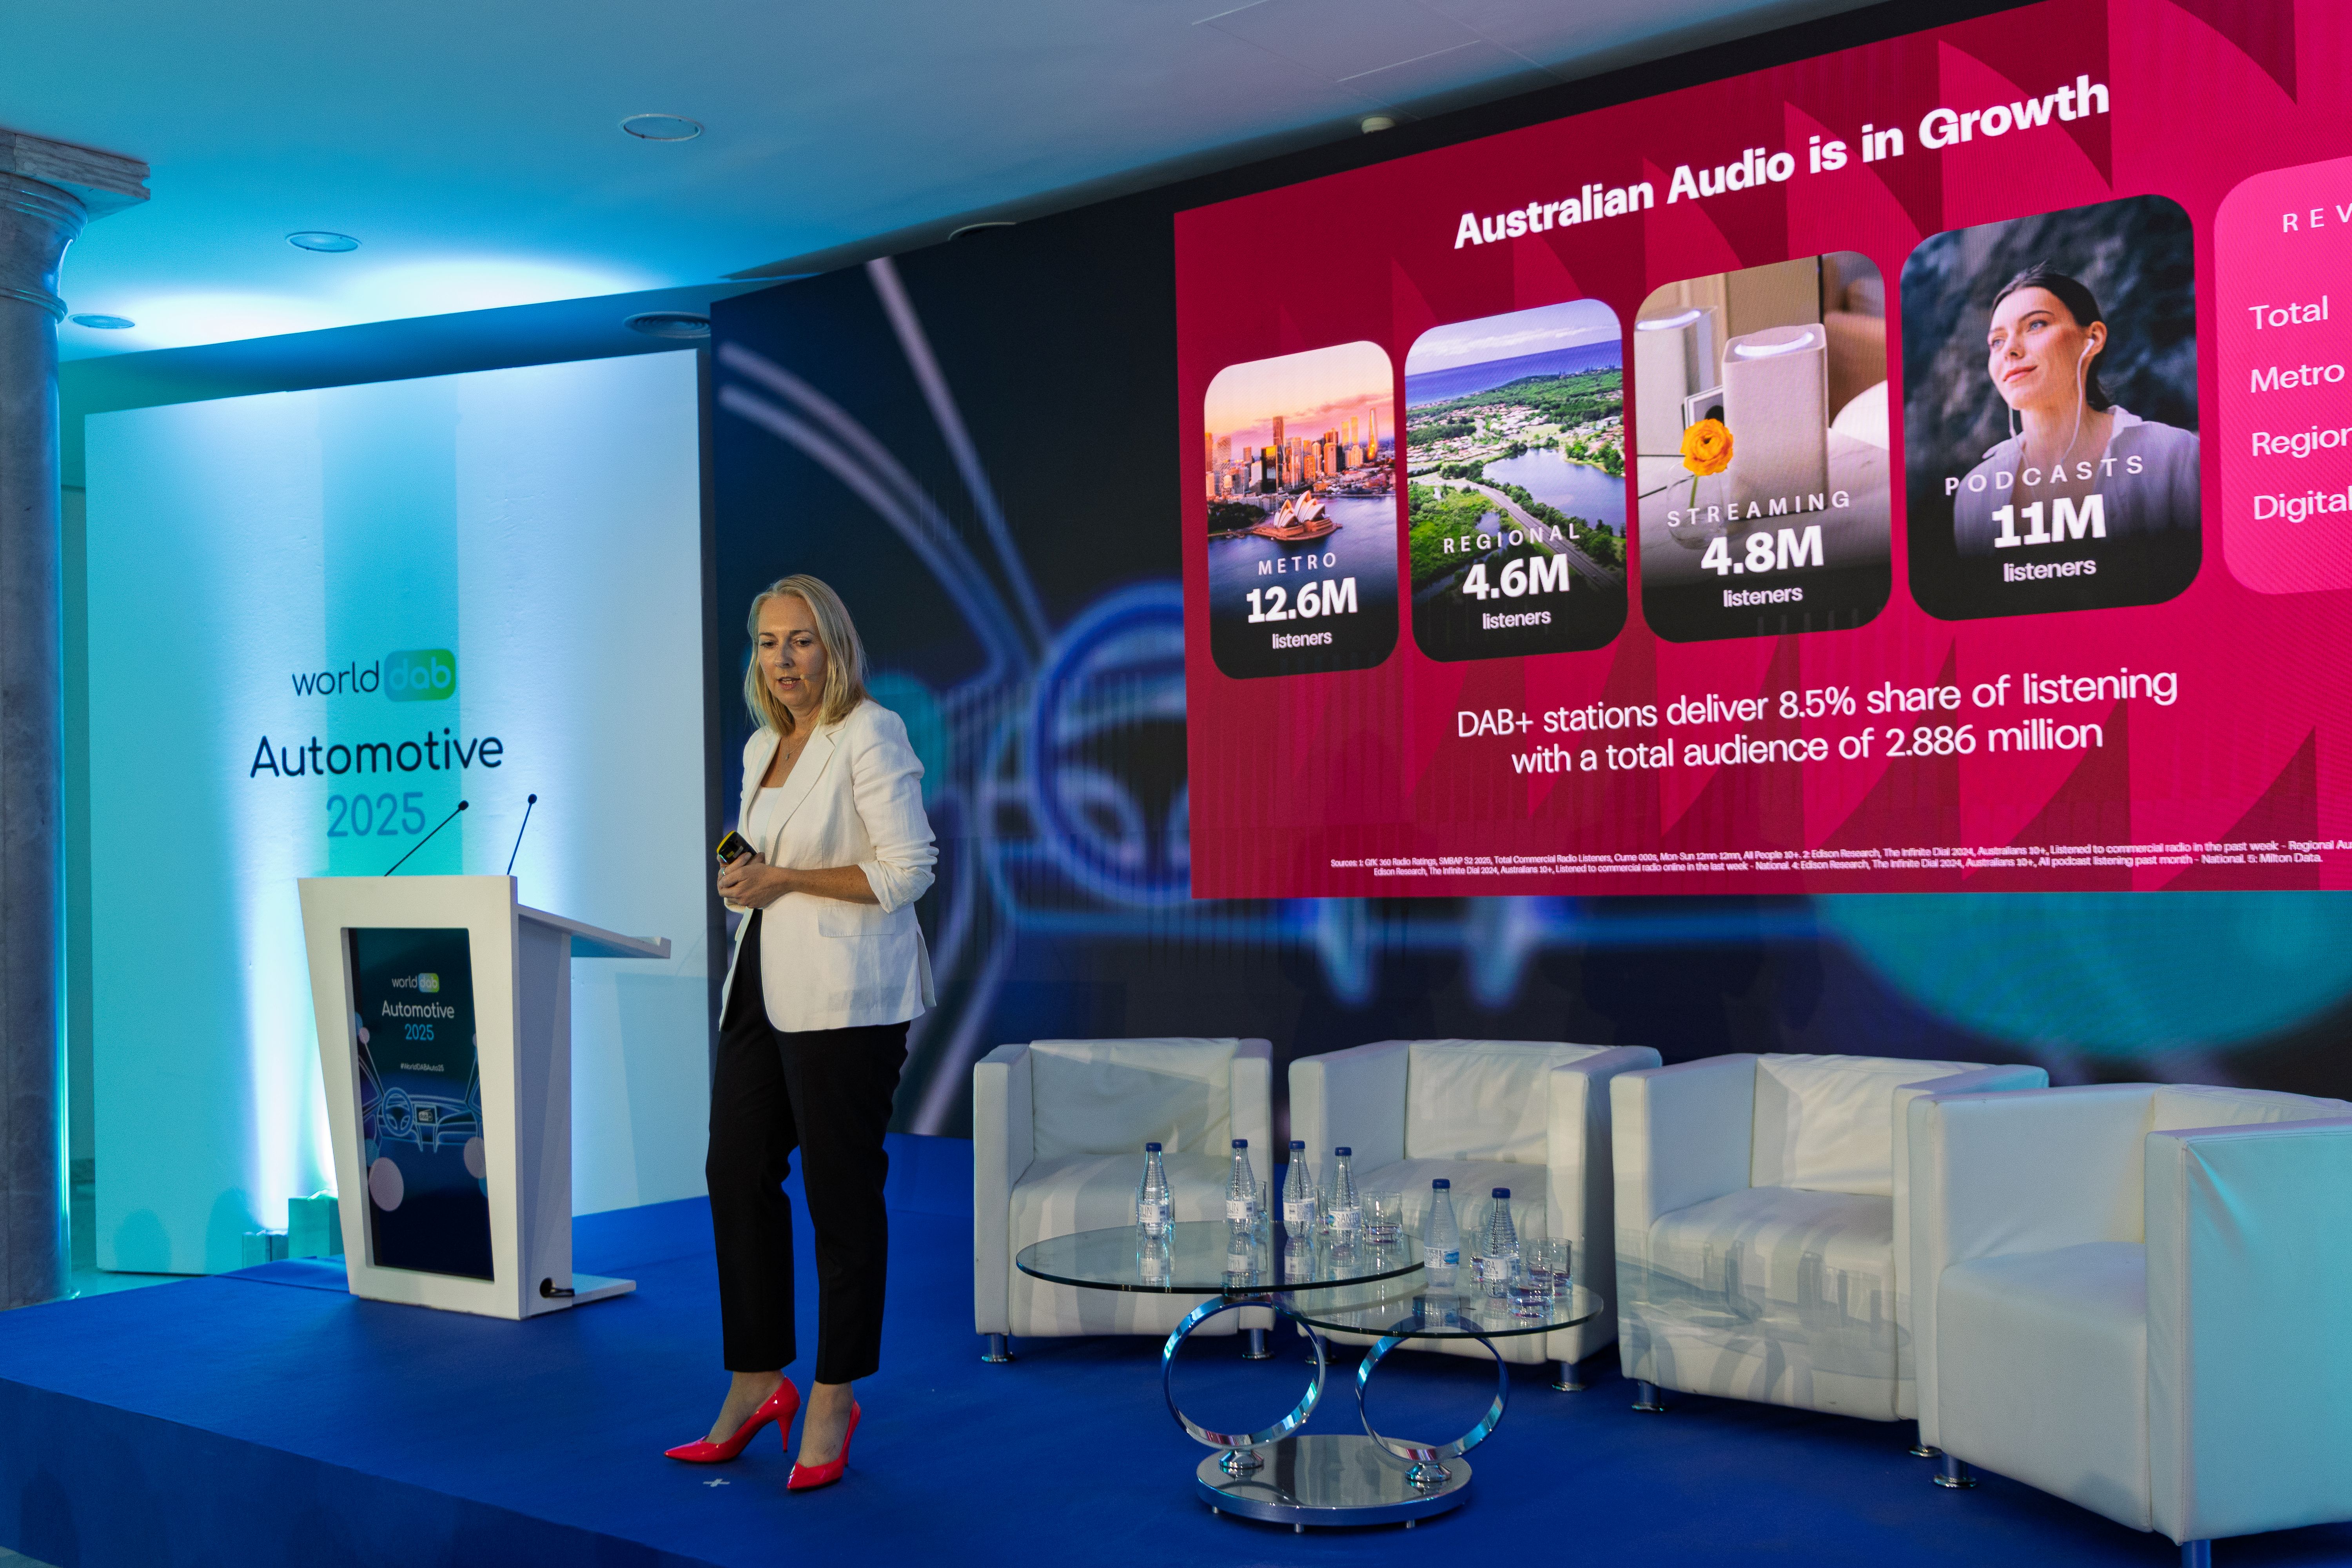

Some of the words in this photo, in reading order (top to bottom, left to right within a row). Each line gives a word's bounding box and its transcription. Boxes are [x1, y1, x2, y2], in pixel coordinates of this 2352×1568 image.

[1454, 182, 1654, 250] Australian
[1666, 147, 1795, 205] Audio
[1809, 135, 1847, 174] is
[1861, 123, 1904, 163] in
[1918, 74, 2109, 149] Growth
[2248, 294, 2328, 330] Total
[2250, 364, 2345, 393] Metro
[1945, 455, 2143, 496] PODCASTS
[1667, 489, 1850, 528] STREAMING
[1992, 494, 2106, 548] 11M
[2253, 485, 2352, 523] Digital
[1443, 523, 1580, 554] REGIONAL
[1701, 525, 1824, 575] 4.8M
[1258, 552, 1336, 576] METRO
[1462, 553, 1570, 600] 4.6M
[2003, 559, 2097, 583] listeners
[1246, 577, 1357, 624] 12.6M
[1723, 584, 1803, 608] listeners
[1482, 611, 1552, 630] listeners
[1272, 632, 1333, 650] listeners
[292, 660, 379, 696] world
[389, 656, 452, 691] dab
[1457, 708, 1534, 738] DAB+
[1543, 701, 1658, 733] stations
[1666, 693, 1769, 726] deliver
[1779, 686, 1856, 719] 8.5%
[1866, 681, 1961, 714] share
[1972, 673, 2011, 708] of
[2023, 667, 2178, 706] listening
[250, 728, 503, 778] Automotive
[1511, 743, 1572, 774] with
[1579, 749, 1597, 771] a
[1605, 737, 1674, 770] total
[1683, 733, 1829, 766] audience
[1838, 727, 1875, 760] of
[1885, 724, 1976, 757] 2.886
[1988, 717, 2103, 752] million
[327, 791, 425, 837] 2025
[1331, 859, 1357, 867] Sources:
[1392, 857, 1411, 866] Radio
[1412, 857, 1438, 867] Ratings,
[1494, 856, 1512, 864] Total
[1513, 855, 1556, 864] Commercial
[1557, 854, 1578, 863] Radio
[1578, 854, 1613, 864] Listeners,
[1614, 853, 1637, 862] Cume
[1743, 851, 1754, 860] All
[1755, 851, 1783, 861] People
[1811, 849, 1840, 858] Edison
[1840, 848, 1882, 859] Research,
[1883, 848, 1900, 857] The
[1901, 848, 1932, 857] Infinite
[1932, 847, 1950, 857] Dial
[1977, 846, 2027, 856] Australians
[2050, 844, 2091, 855] Listened
[2092, 844, 2105, 854] to
[2105, 843, 2164, 853] commercial
[2165, 842, 2192, 852] radio
[2192, 842, 2203, 852] in
[2204, 841, 2222, 852] the
[2223, 842, 2247, 854] past
[2249, 840, 2279, 851] week
[2288, 840, 2334, 853] Regional
[1374, 867, 1395, 876] Edison
[1396, 867, 1428, 877] Research,
[1428, 866, 1442, 875] The
[1443, 866, 1466, 875] Infinite
[1466, 866, 1480, 875] Dial
[1501, 866, 1539, 874] Australians
[1555, 864, 1587, 873] Listened
[1588, 864, 1597, 873] to
[1597, 864, 1641, 873] commercial
[1642, 863, 1662, 872] radio
[1663, 863, 1686, 872] online
[1686, 862, 1695, 871] in
[1695, 862, 1710, 871] the
[1710, 862, 1725, 871] last
[1726, 861, 1749, 871] week
[1800, 860, 1829, 870] Edison
[1829, 859, 1871, 870] Research,
[1871, 859, 1889, 869] The
[1890, 859, 1920, 869] Infinite
[1921, 858, 1938, 868] Dial
[1965, 858, 2015, 867] Australians
[2051, 856, 2092, 868] podcast
[2092, 856, 2133, 868] listening
[2134, 855, 2158, 867] past
[2158, 854, 2193, 864] month
[2259, 853, 2292, 863] Milton
[392, 976, 417, 988] world
[420, 977, 438, 989] dab
[382, 1000, 455, 1018] Automotive
[405, 1024, 434, 1040] 2025
